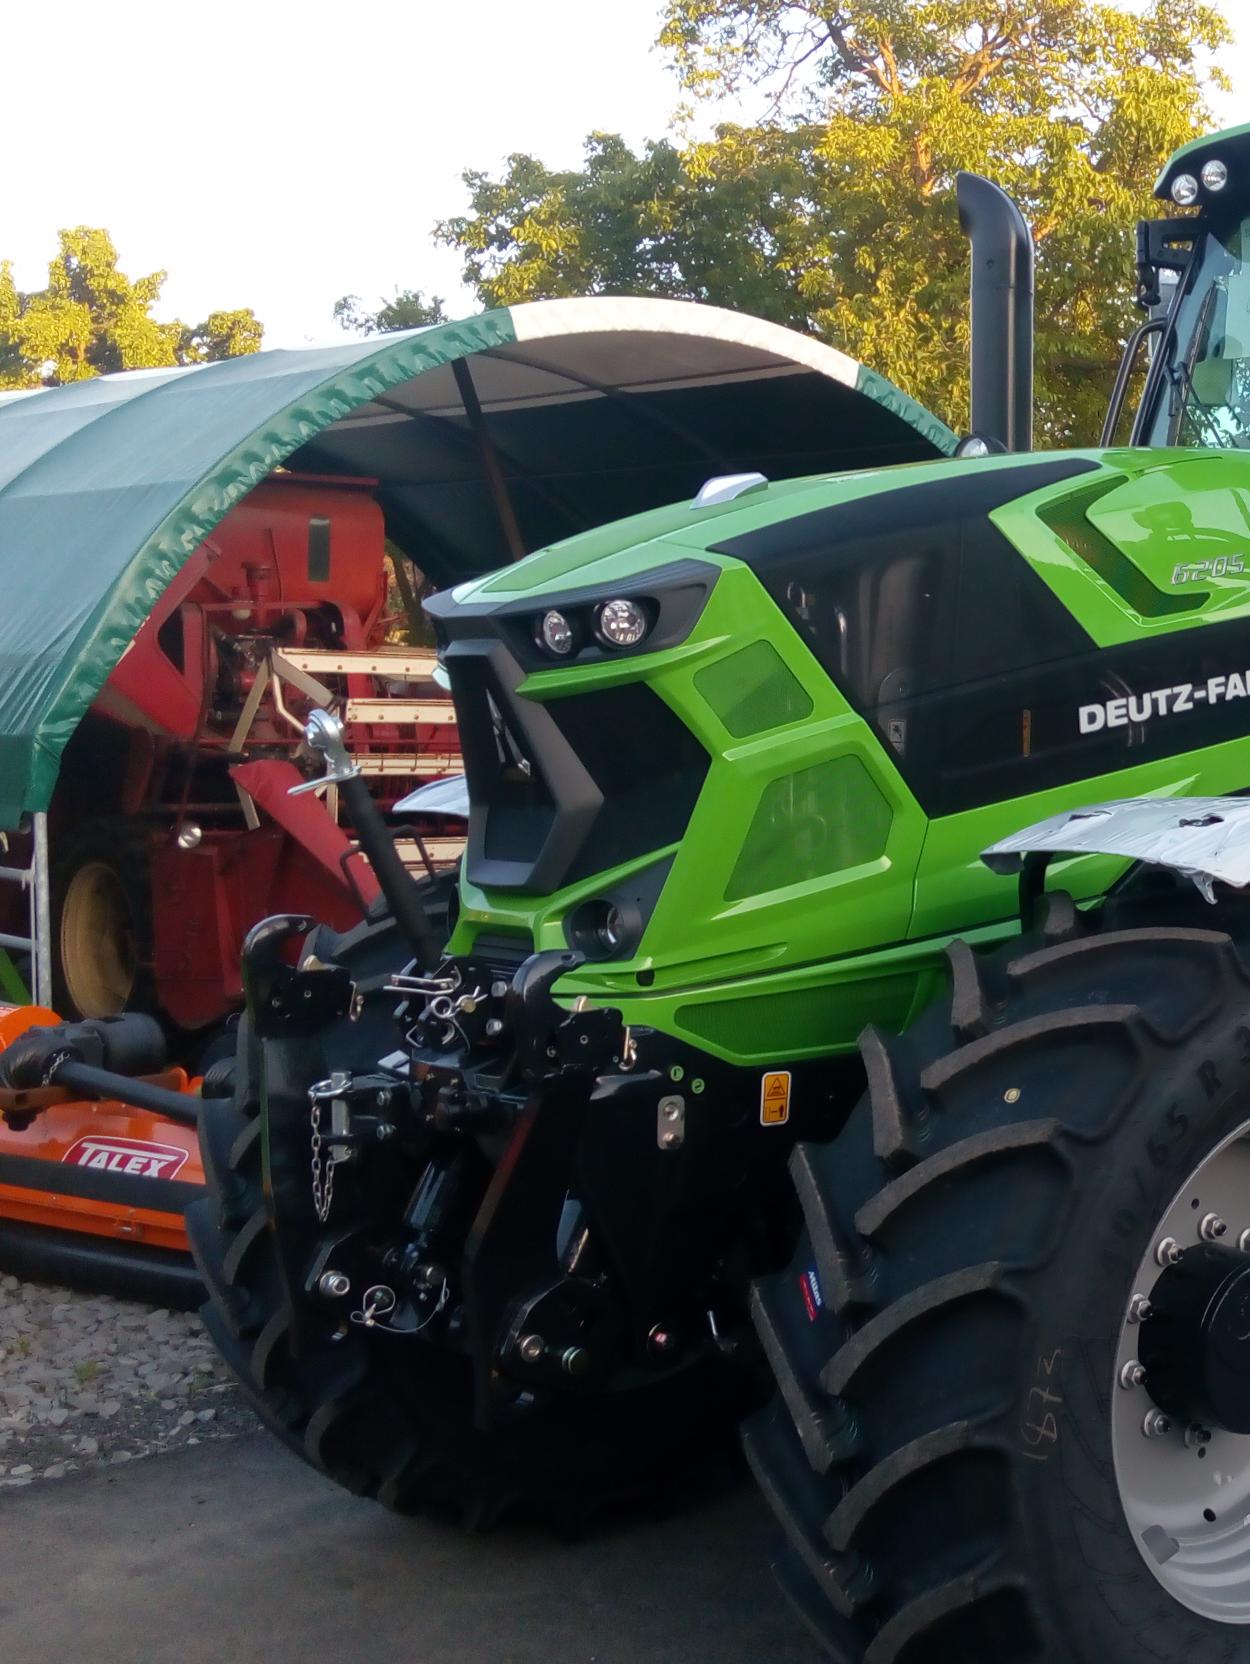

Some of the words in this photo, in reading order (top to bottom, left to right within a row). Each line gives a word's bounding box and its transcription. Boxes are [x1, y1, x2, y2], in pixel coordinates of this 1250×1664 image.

[1170, 552, 1245, 585] 6205
[1197, 1059, 1222, 1099] R
[78, 1141, 178, 1180] TALEX
